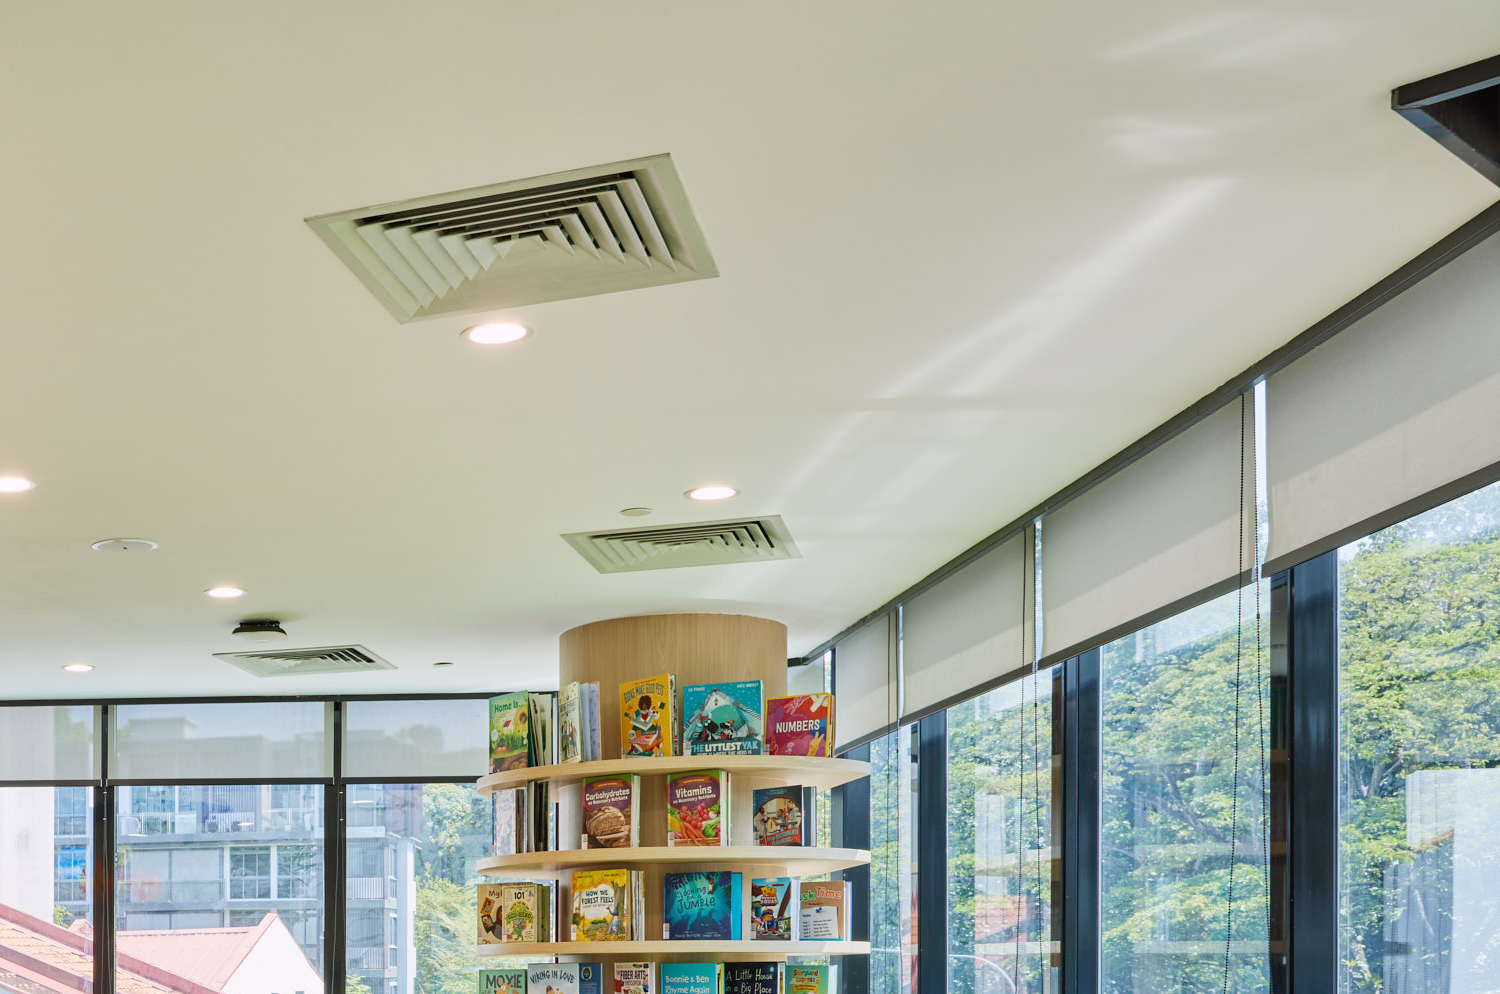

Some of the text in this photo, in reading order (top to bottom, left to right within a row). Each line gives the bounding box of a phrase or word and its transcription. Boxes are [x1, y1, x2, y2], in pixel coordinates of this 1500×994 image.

[494, 702, 512, 713] Home
[775, 719, 821, 734] NUMBERS
[691, 740, 758, 753] THE LITTLEST YAK
[585, 789, 630, 801] Carbohydrates
[675, 786, 712, 799] Vitamins
[514, 891, 525, 900] 101
[800, 885, 842, 902] sk Time
[581, 896, 614, 905] FOREST FEELS
[529, 970, 575, 984] VIKING IN LOVE
[620, 970, 633, 980] FIBER
[634, 970, 646, 980] ARTS
[665, 975, 689, 984] Bonnie
[696, 975, 710, 984] Ben
[726, 968, 773, 981] A Little House
[485, 974, 523, 989] MOXIE
